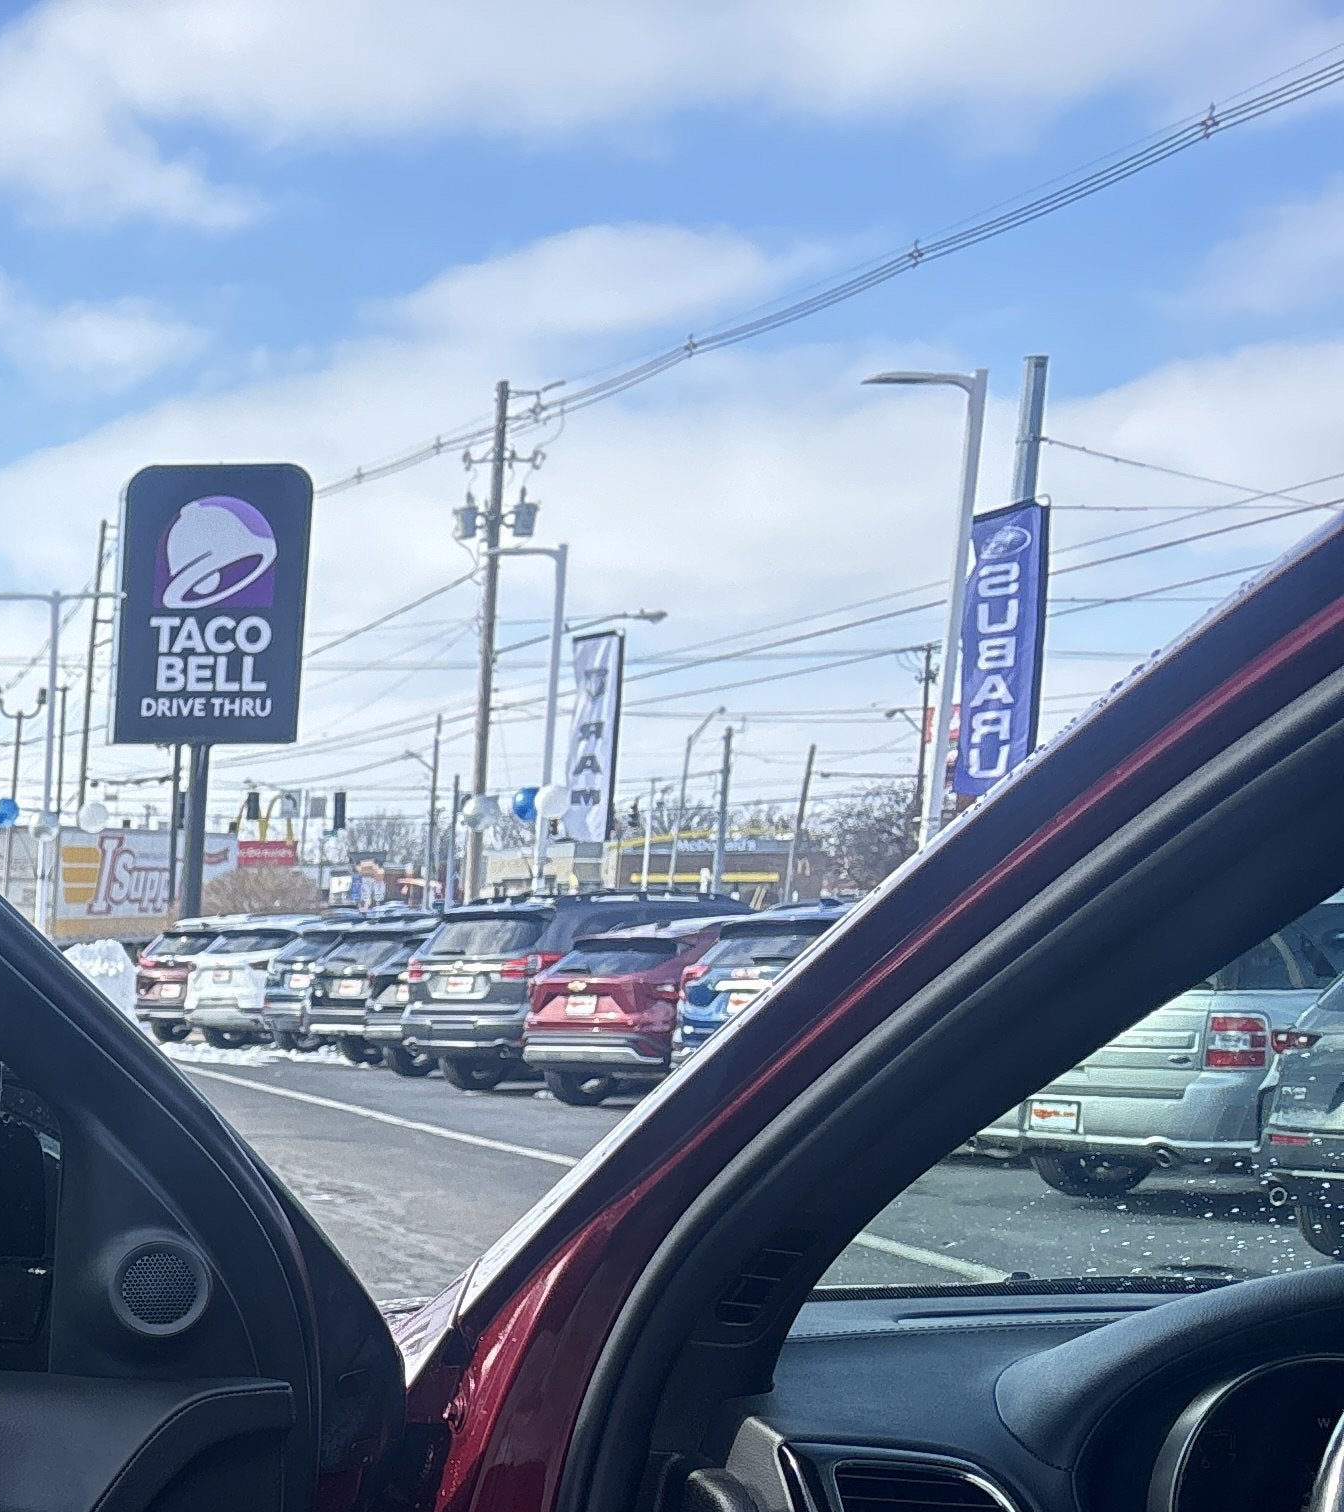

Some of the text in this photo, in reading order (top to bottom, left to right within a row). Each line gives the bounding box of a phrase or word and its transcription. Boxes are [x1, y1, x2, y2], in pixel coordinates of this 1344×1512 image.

[150, 616, 272, 654] TACO
[156, 655, 267, 692] BELL
[141, 697, 272, 718] DRIVE THRU
